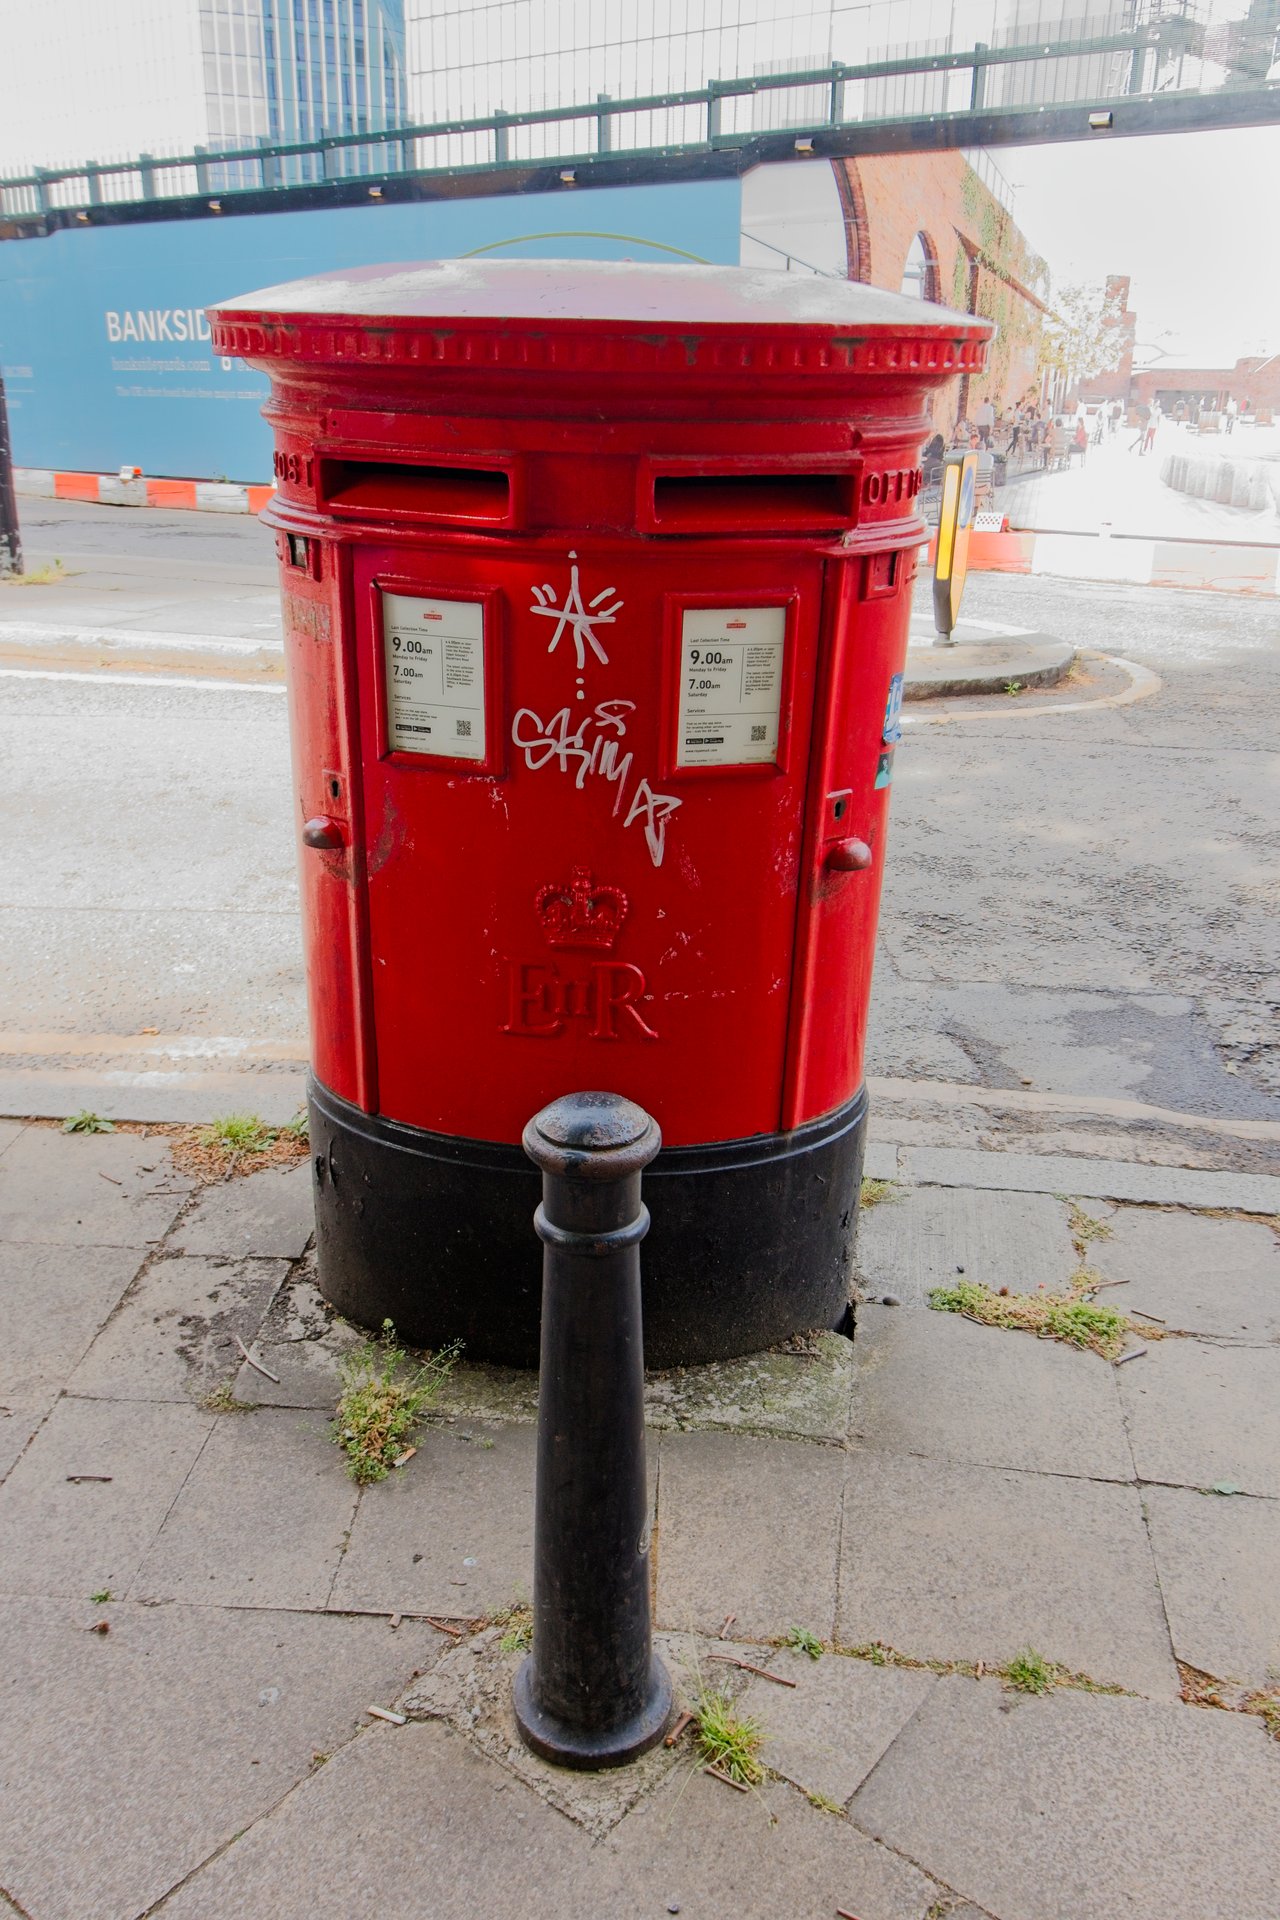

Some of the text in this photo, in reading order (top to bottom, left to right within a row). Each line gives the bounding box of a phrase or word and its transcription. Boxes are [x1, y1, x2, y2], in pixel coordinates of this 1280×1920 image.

[392, 636, 433, 655] 9.00am
[690, 649, 733, 665] 9.00am
[393, 665, 424, 678] 7.00am
[688, 679, 721, 690] 7.00am
